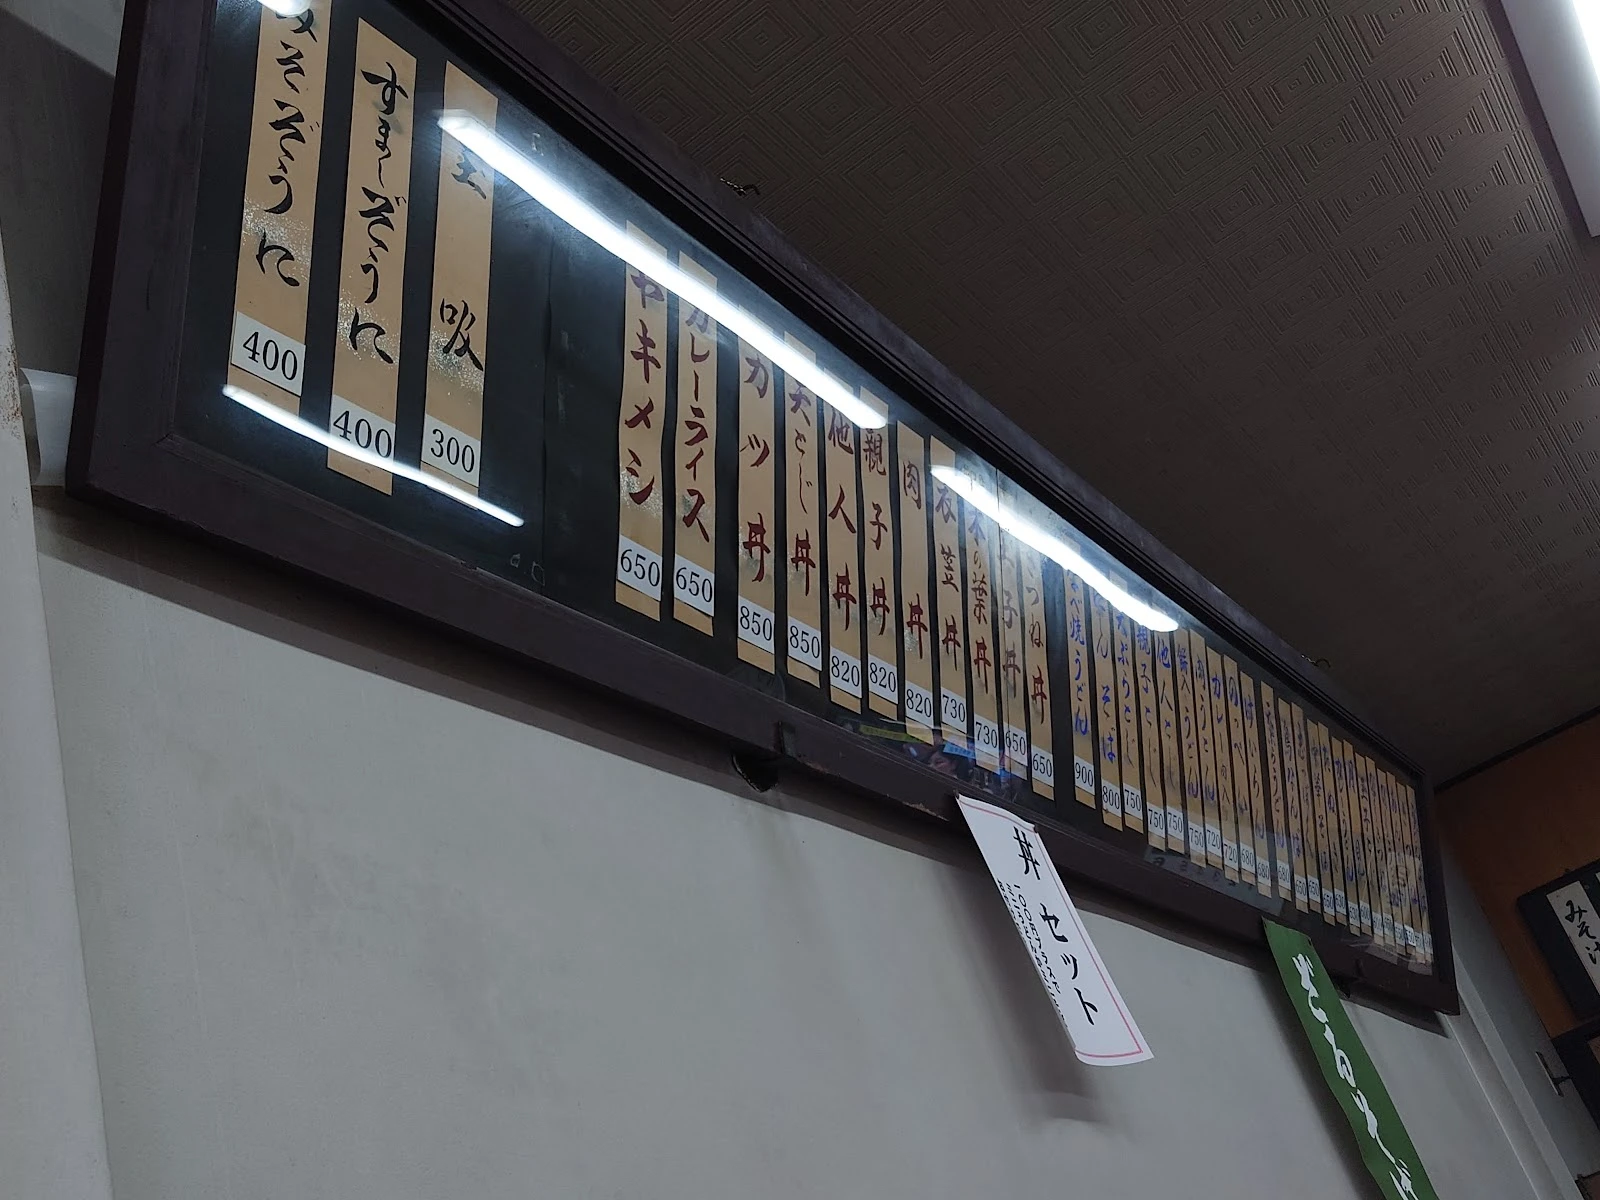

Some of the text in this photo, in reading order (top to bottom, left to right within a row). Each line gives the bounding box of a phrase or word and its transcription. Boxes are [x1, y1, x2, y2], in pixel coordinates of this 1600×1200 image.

[242, 332, 298, 382] 400
[624, 270, 664, 505] ヤキメシ
[333, 410, 392, 460] 400
[429, 428, 475, 474] 300
[740, 355, 770, 582] カツ丼
[827, 410, 857, 631] 他人丼
[863, 429, 890, 636] 親子丼
[620, 548, 661, 588] 650
[902, 460, 928, 659] 肉丼
[675, 567, 713, 604] 650
[935, 484, 961, 671] 衣笠丼
[739, 605, 773, 642] 850
[789, 625, 821, 660] 850
[831, 655, 860, 687] 820
[869, 663, 897, 693] 820
[905, 690, 932, 718] 820
[942, 694, 966, 723] 730
[975, 721, 998, 749] 730
[1005, 730, 1026, 756] 650
[1032, 753, 1053, 778] 650
[1075, 762, 1093, 787] 900
[1102, 785, 1120, 810] 800
[1124, 789, 1142, 812] 750
[1148, 809, 1164, 830] 750
[1168, 812, 1183, 834] 750
[1189, 827, 1204, 848] 750
[1206, 829, 1220, 850] 720
[1223, 843, 1238, 864] 720
[1013, 826, 1098, 1026] 丼セット
